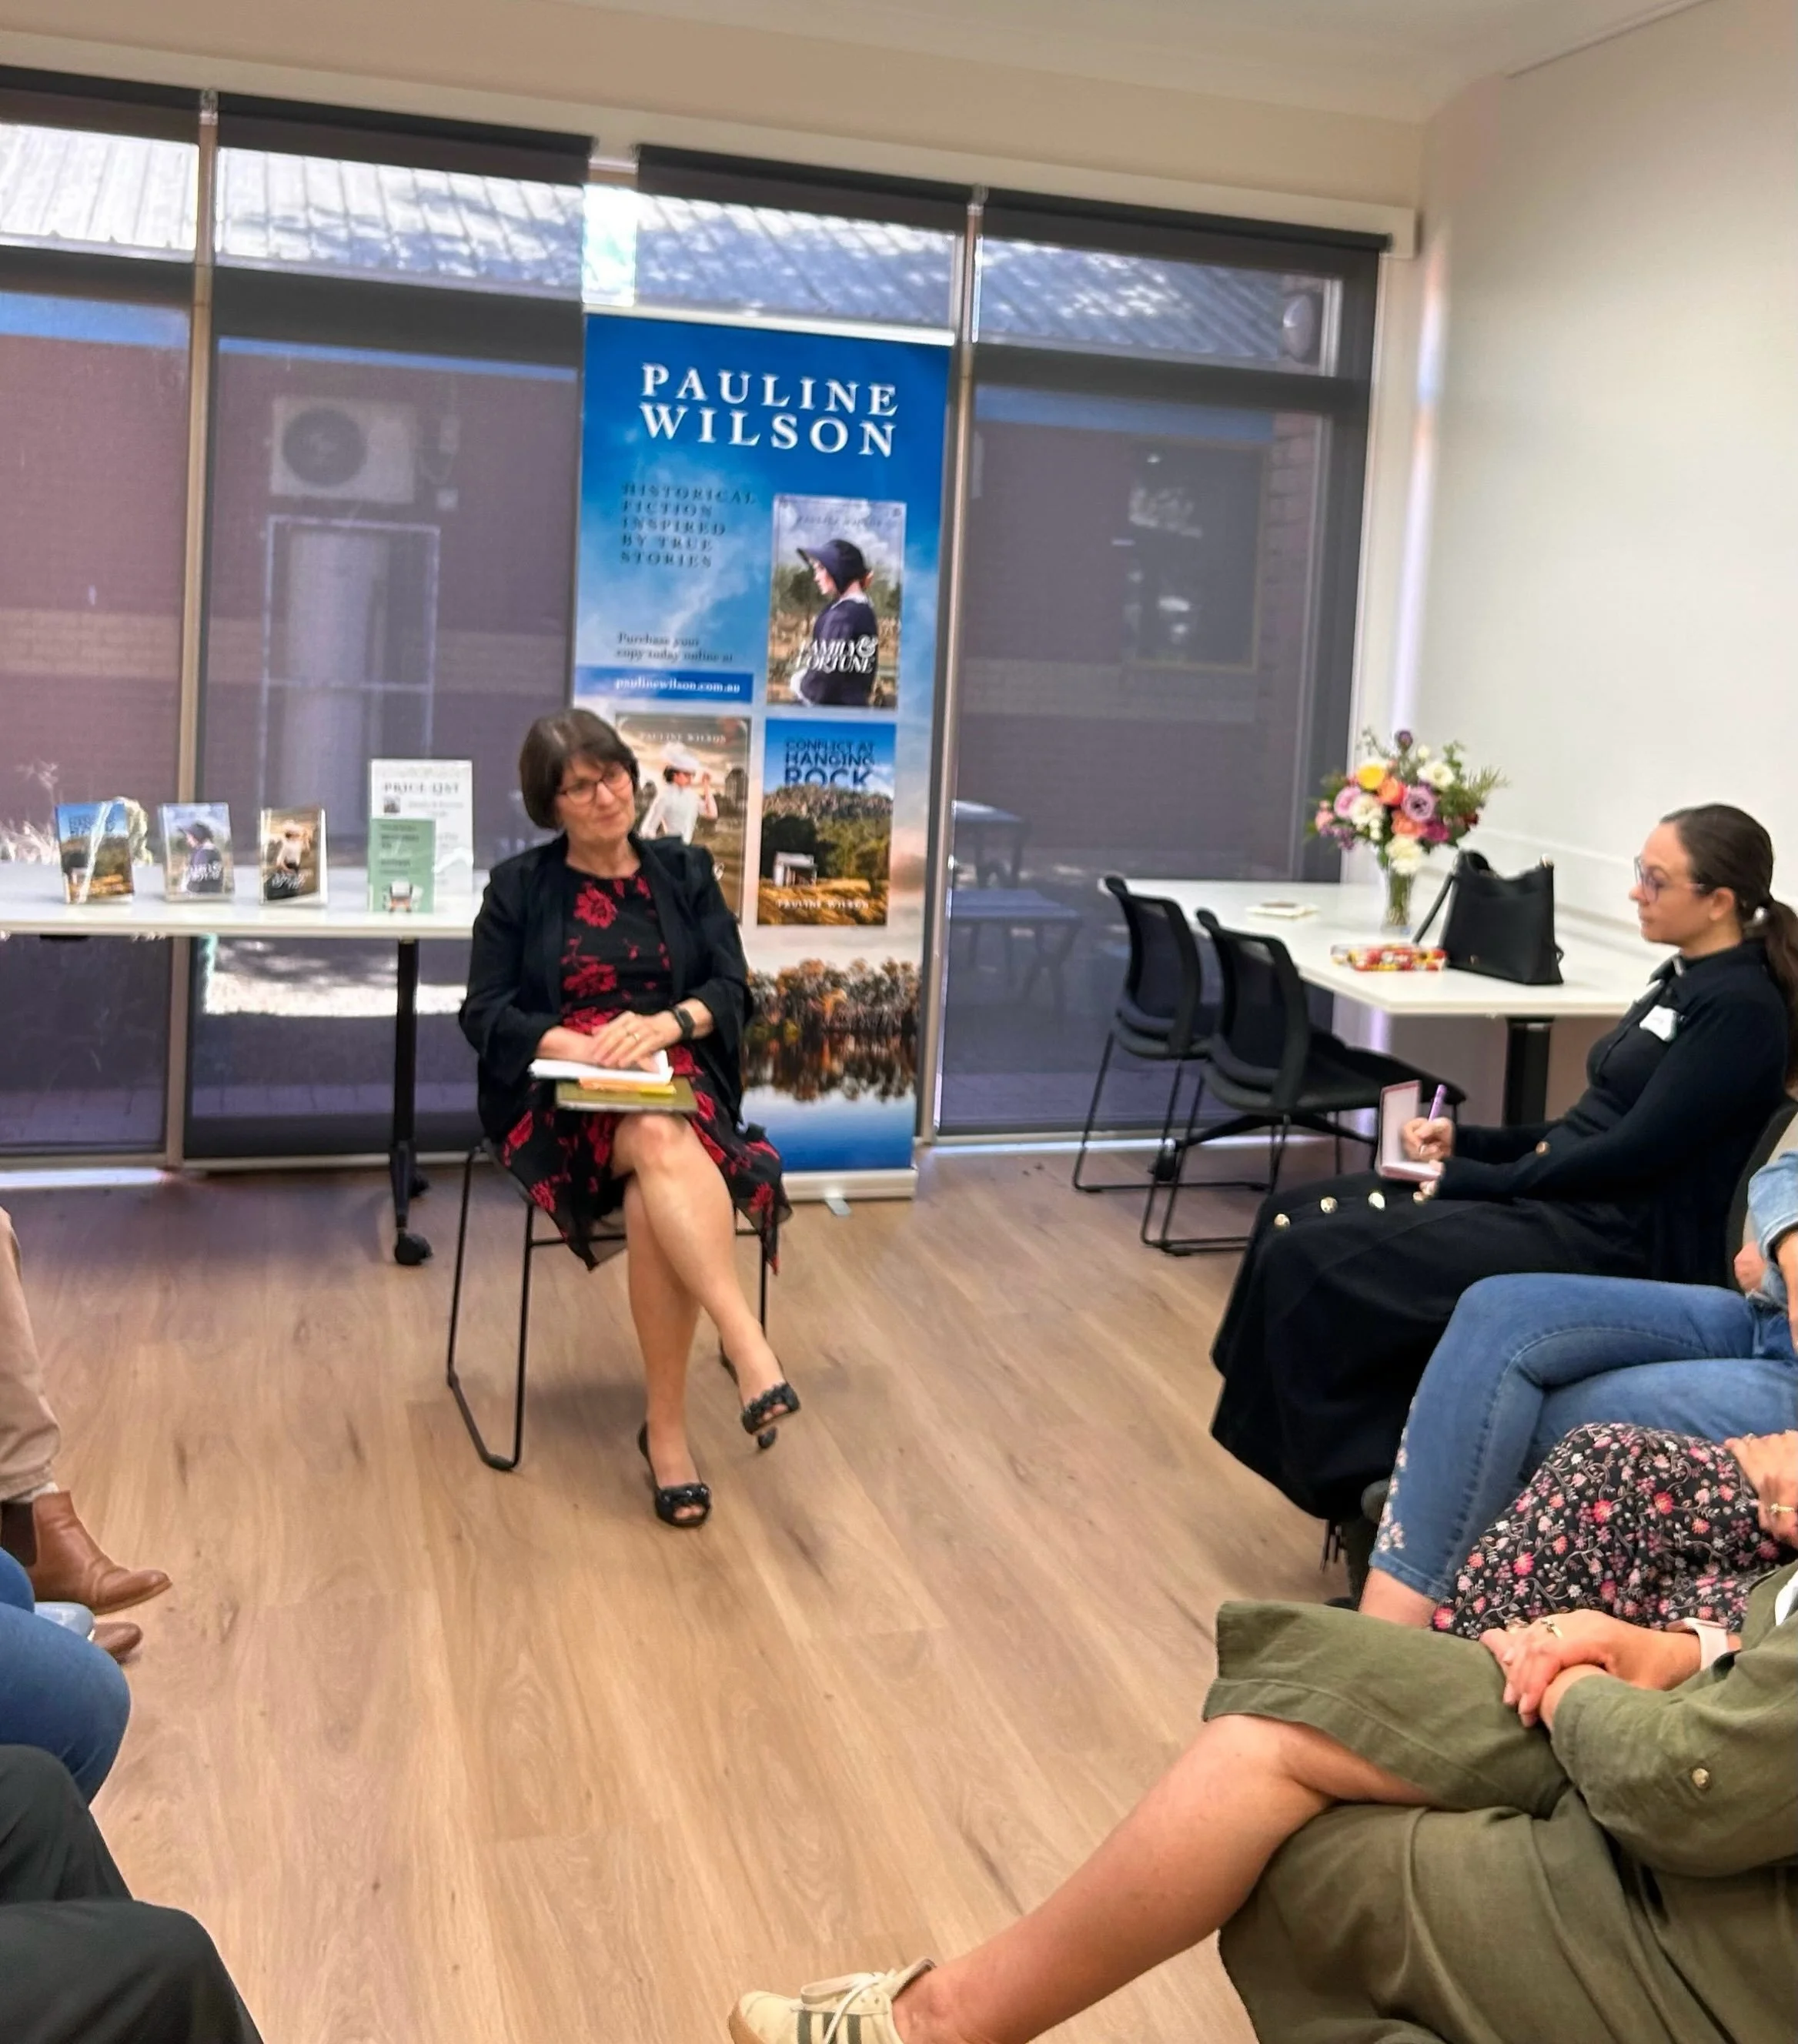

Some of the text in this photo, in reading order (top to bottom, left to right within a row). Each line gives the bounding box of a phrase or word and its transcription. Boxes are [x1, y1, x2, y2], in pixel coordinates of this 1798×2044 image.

[641, 362, 899, 417] PAULINE
[639, 402, 897, 458] WILSON
[621, 481, 757, 505] HISTORICAL
[622, 501, 713, 517] FICTION
[622, 517, 726, 536] INSPIRED
[622, 534, 713, 552] BY TRUE
[620, 551, 713, 569] STORIES
[617, 632, 700, 648] Purchase your
[797, 637, 860, 656] FAMILY
[617, 649, 645, 660] copy
[649, 650, 679, 663] today
[684, 650, 720, 662] online
[795, 654, 876, 674] FORTUNE
[615, 676, 741, 693] paulinewilson.com.au
[785, 738, 875, 753] CONFLICT AT
[784, 750, 876, 767] HANGING
[784, 766, 874, 787] ROCK
[384, 781, 460, 796] PRICE LIST
